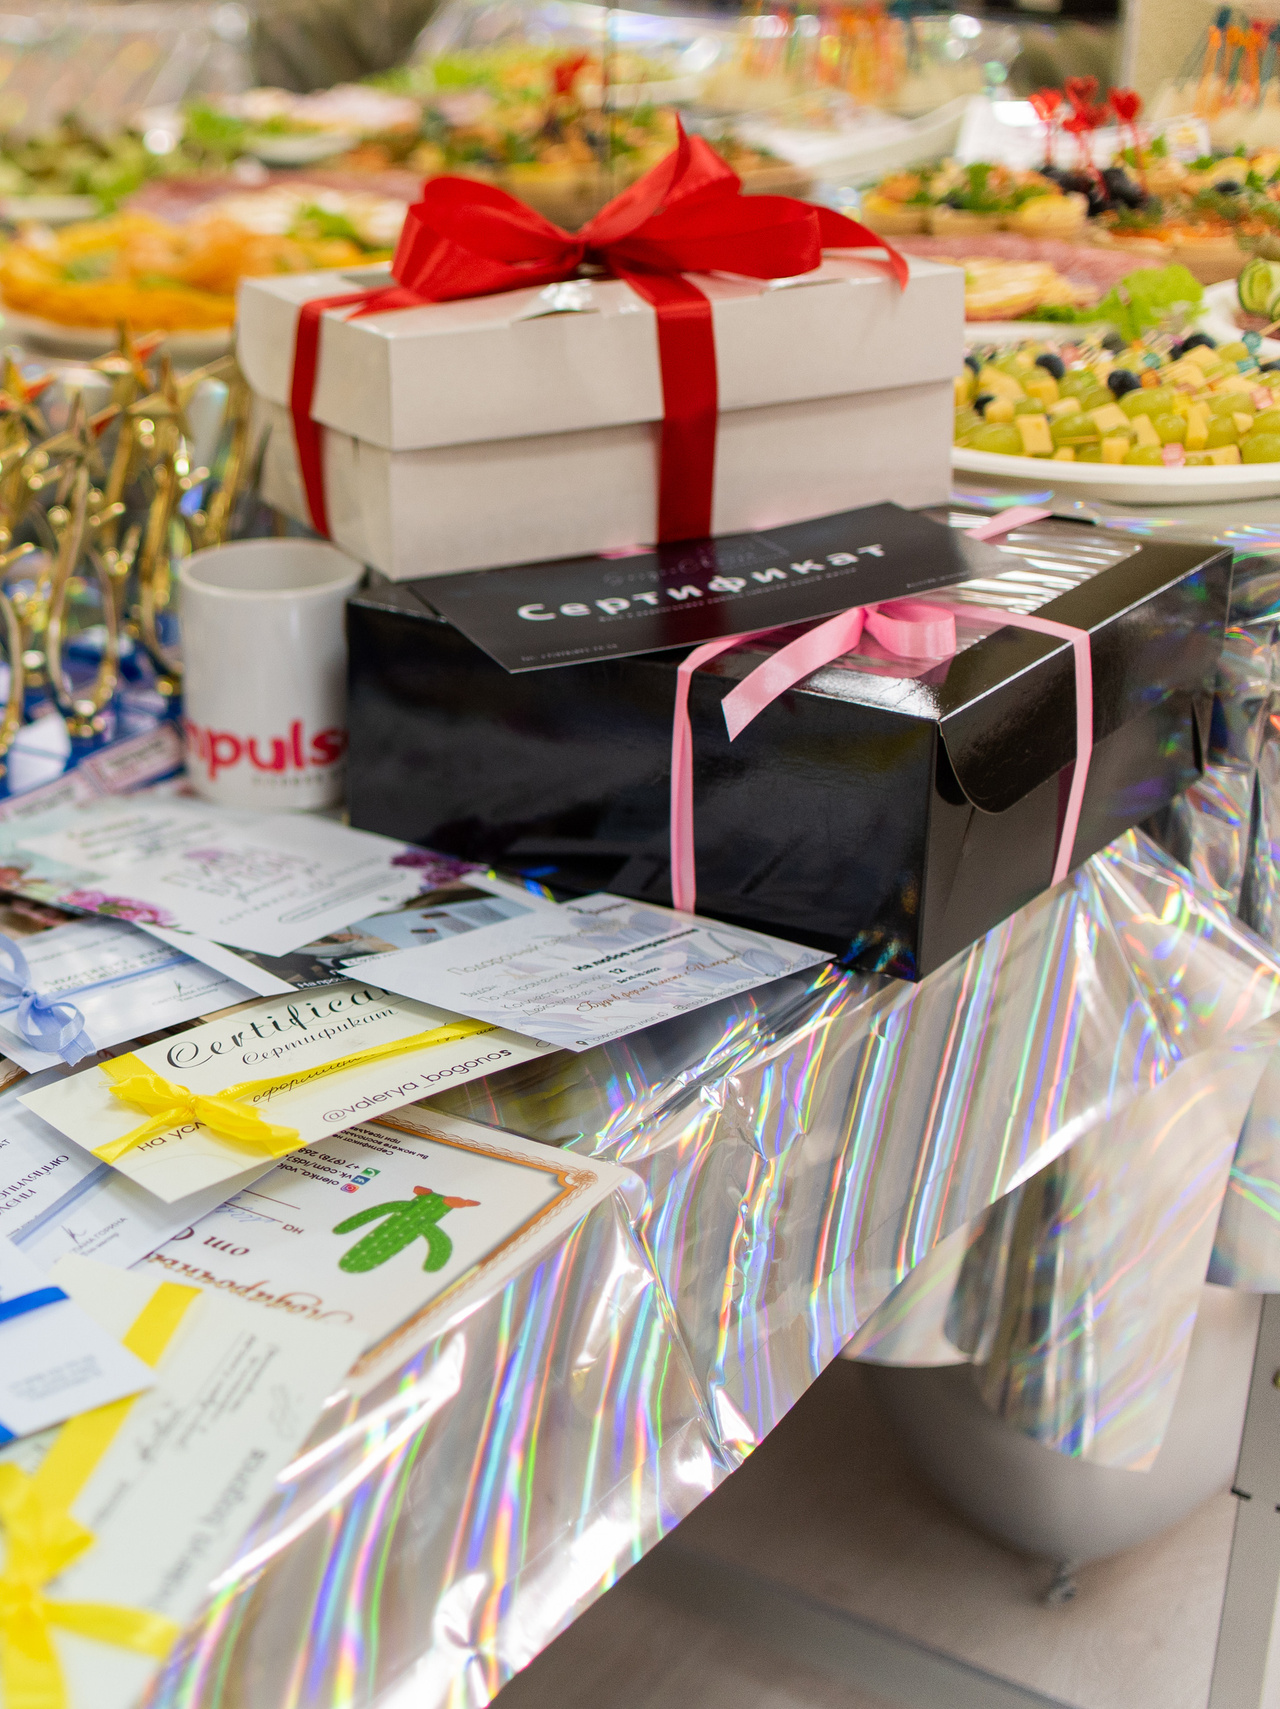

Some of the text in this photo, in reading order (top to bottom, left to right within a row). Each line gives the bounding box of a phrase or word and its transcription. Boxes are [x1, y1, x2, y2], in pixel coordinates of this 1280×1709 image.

[517, 543, 885, 622] Сертификат
[242, 1009, 399, 1066] Сертификат
[322, 1049, 513, 1123] @valerya_bogonos
[170, 1119, 208, 1149] усл
[343, 1137, 395, 1156] Сертификат
[285, 1153, 353, 1180] vk.com/id57
[319, 1153, 347, 1166] (978)
[203, 1235, 250, 1256] от
